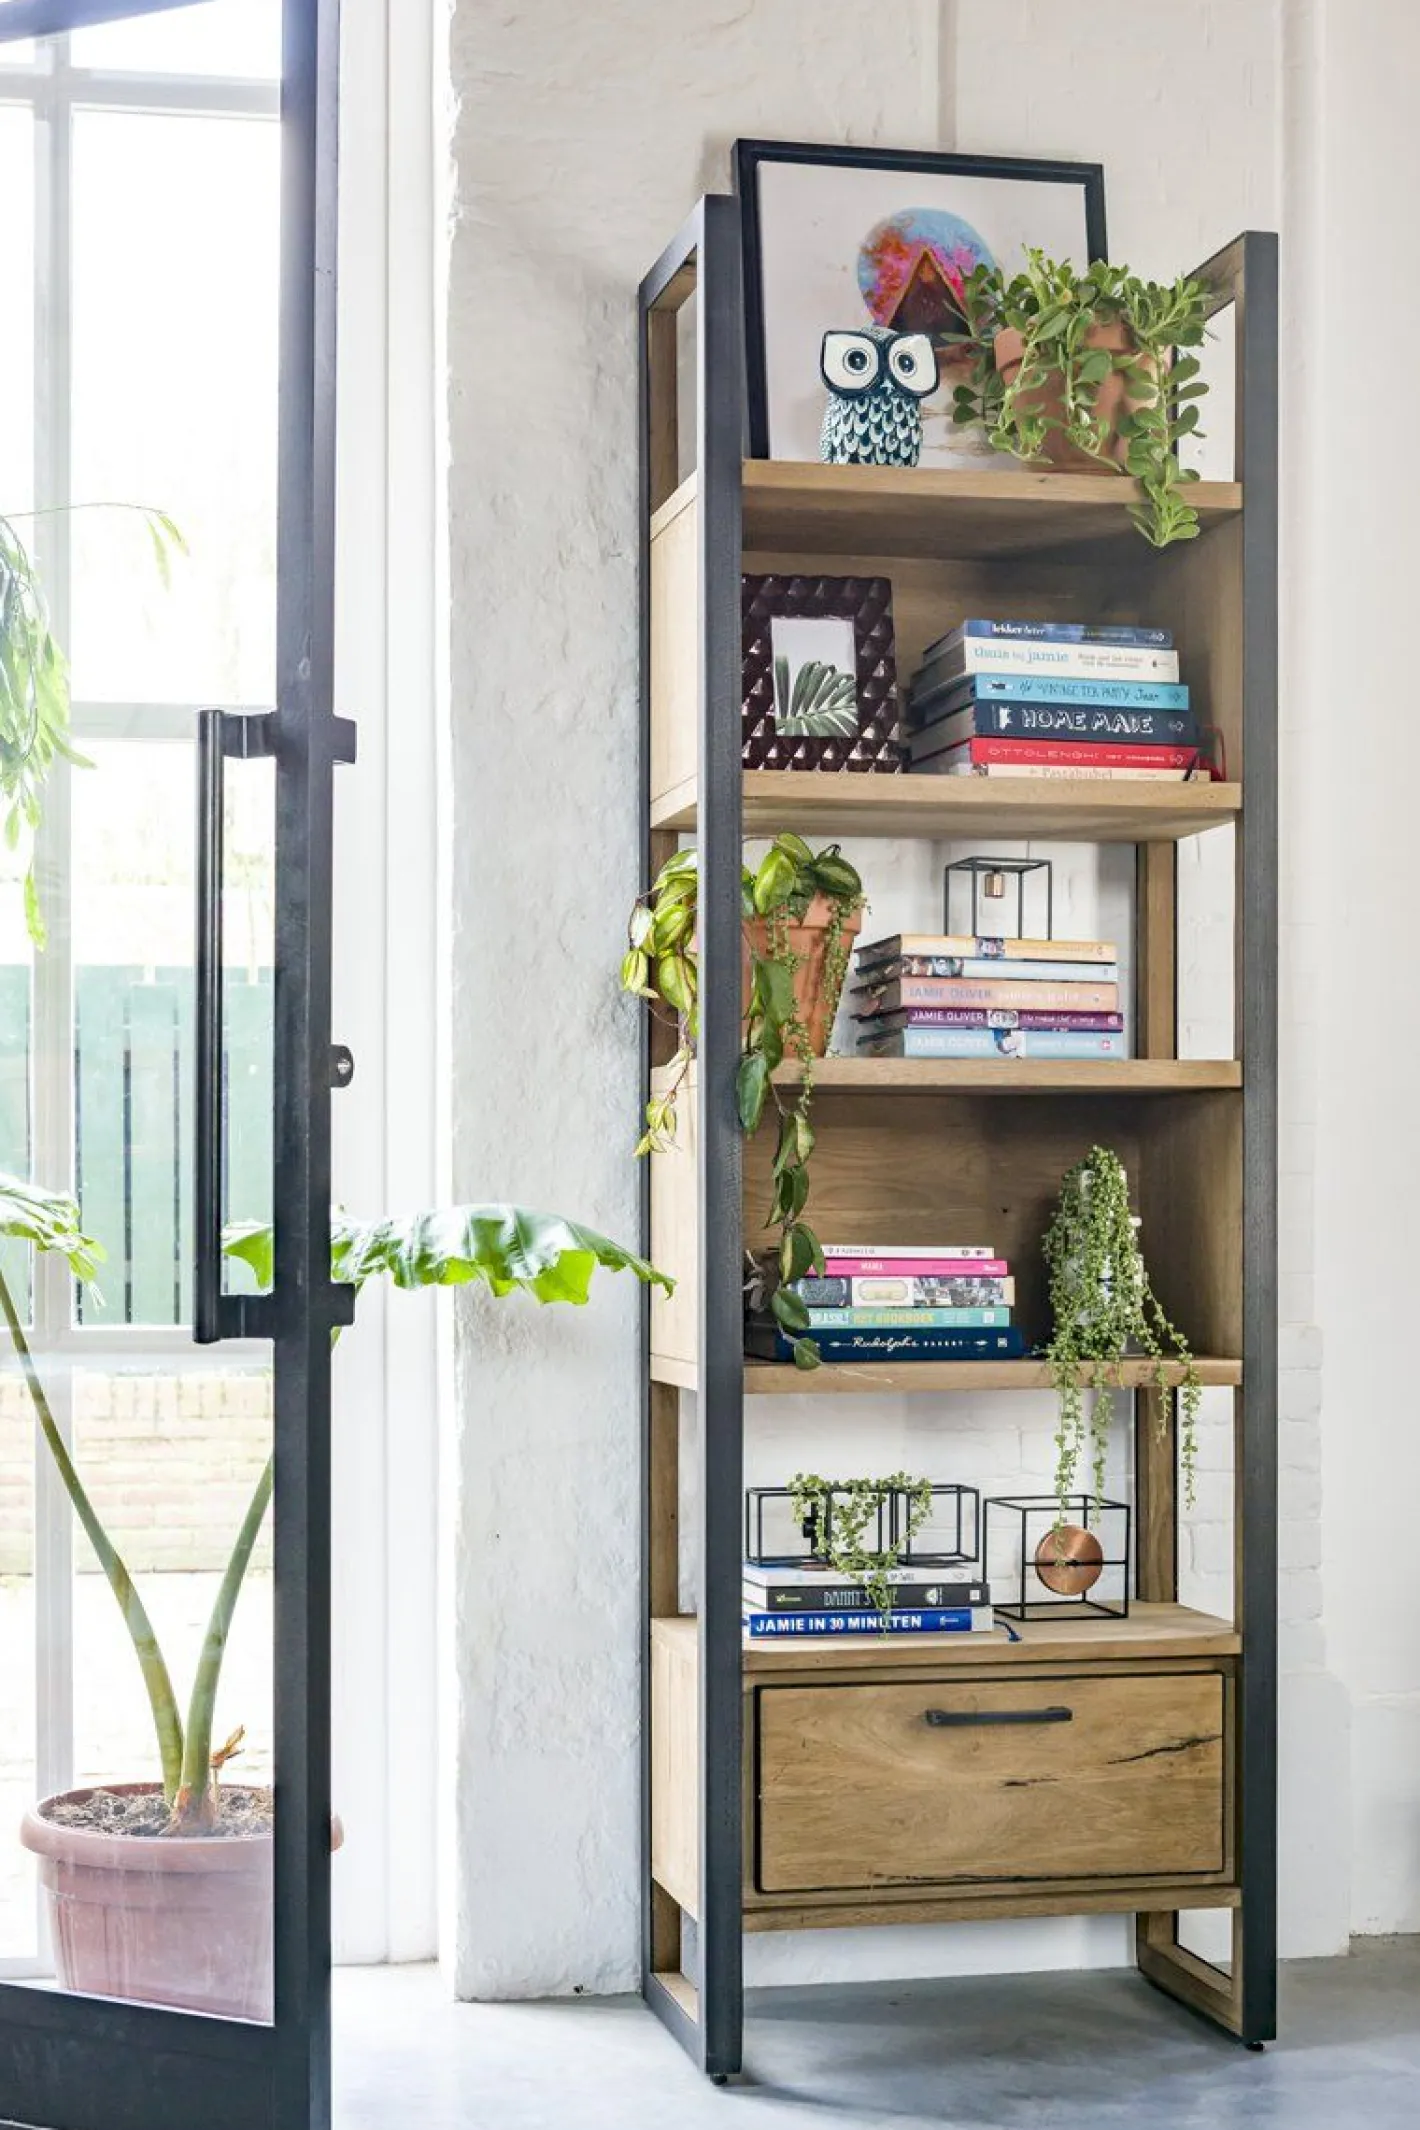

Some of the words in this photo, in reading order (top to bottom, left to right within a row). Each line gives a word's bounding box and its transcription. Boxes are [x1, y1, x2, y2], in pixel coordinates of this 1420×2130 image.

[1021, 707, 1087, 731] HOME
[1091, 711, 1154, 733] MADE
[988, 748, 1099, 760] OTTOLENGHI
[911, 1010, 944, 1022] JAMIE
[947, 1011, 984, 1023] OLIVER
[756, 1617, 804, 1632] JAMIE
[808, 1617, 827, 1631] IN
[830, 1616, 845, 1631] 30
[847, 1614, 922, 1631] MINUTEN
